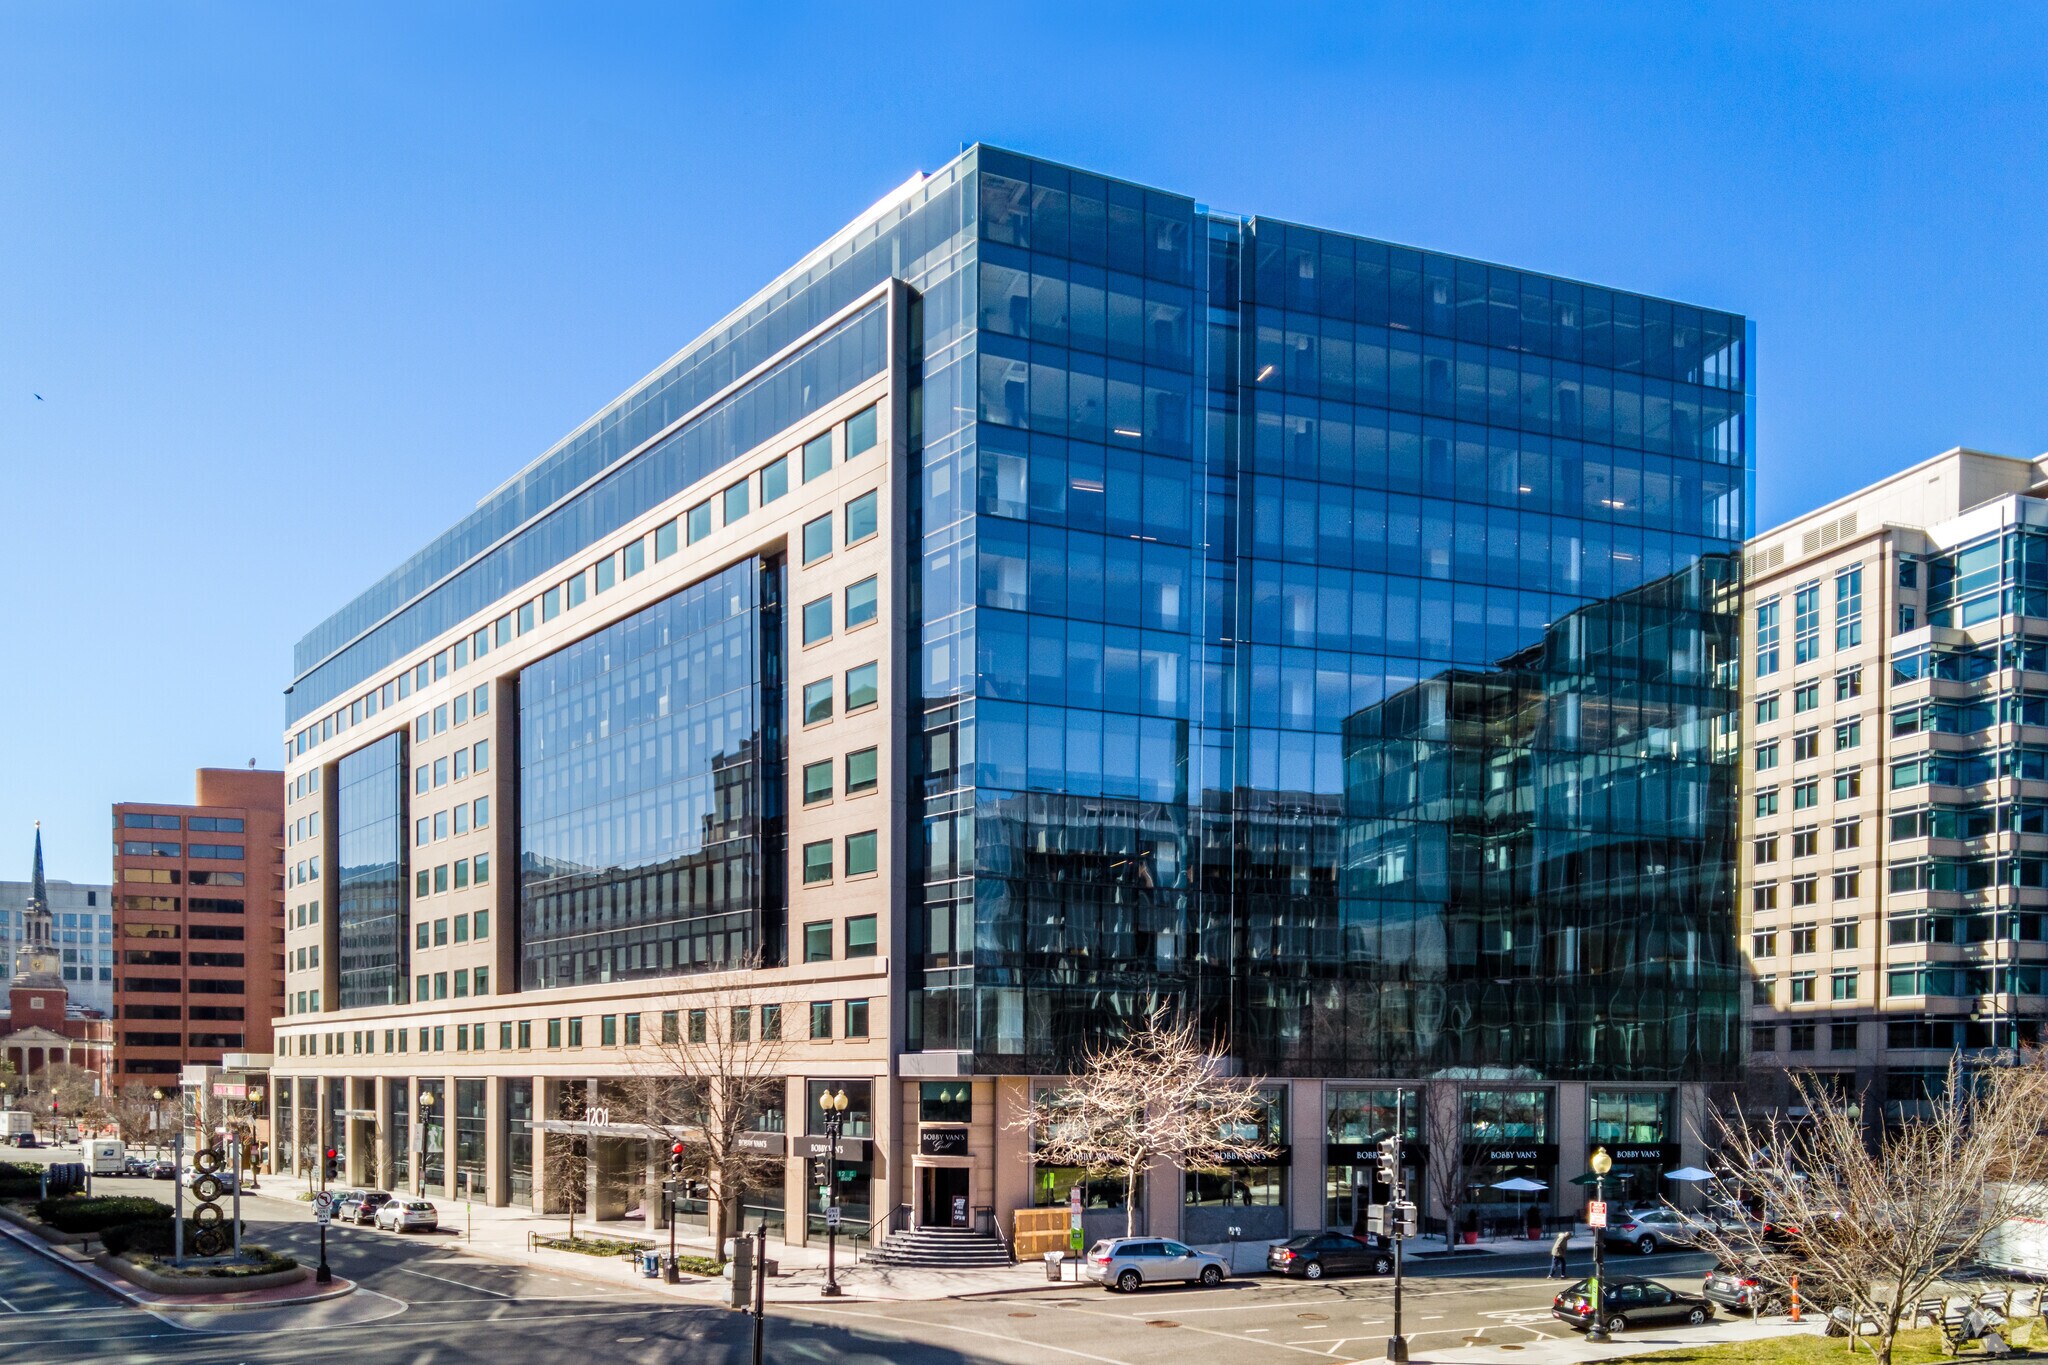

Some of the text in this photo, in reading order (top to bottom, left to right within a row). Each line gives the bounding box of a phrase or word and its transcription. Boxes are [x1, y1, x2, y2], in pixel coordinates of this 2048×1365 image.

[585, 1107, 609, 1127] 1201
[923, 1133, 944, 1141] BOBBY
[811, 1144, 828, 1152] BOBBY
[1491, 1151, 1537, 1159] BOBBY VAN'S
[1617, 1150, 1660, 1158] BOBBY VAN'S
